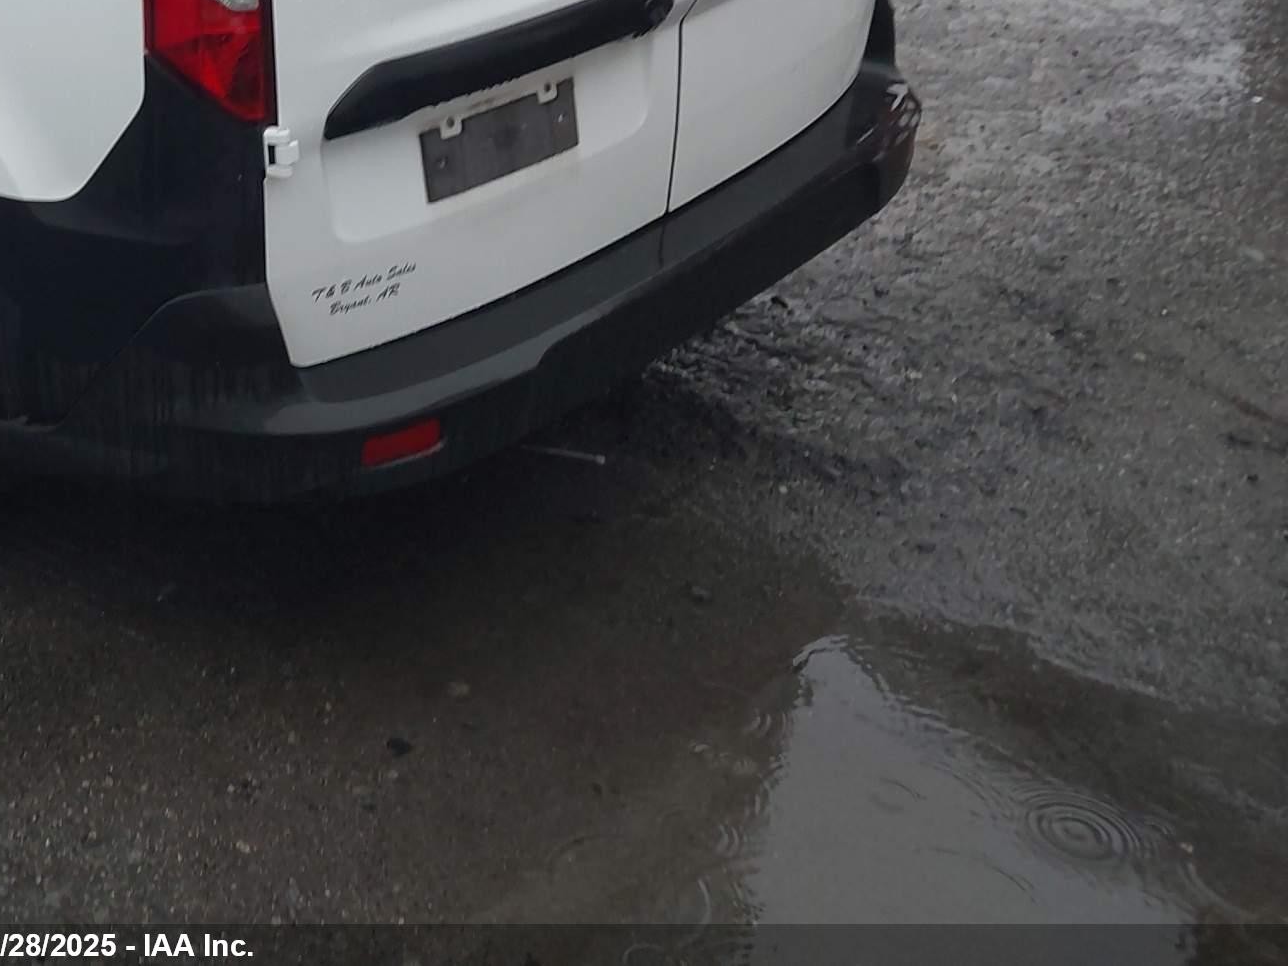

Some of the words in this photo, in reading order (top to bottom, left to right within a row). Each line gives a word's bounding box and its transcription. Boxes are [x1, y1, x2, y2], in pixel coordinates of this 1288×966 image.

[353, 274, 383, 292] Auto
[386, 262, 417, 281] Sales
[375, 283, 402, 303] AR
